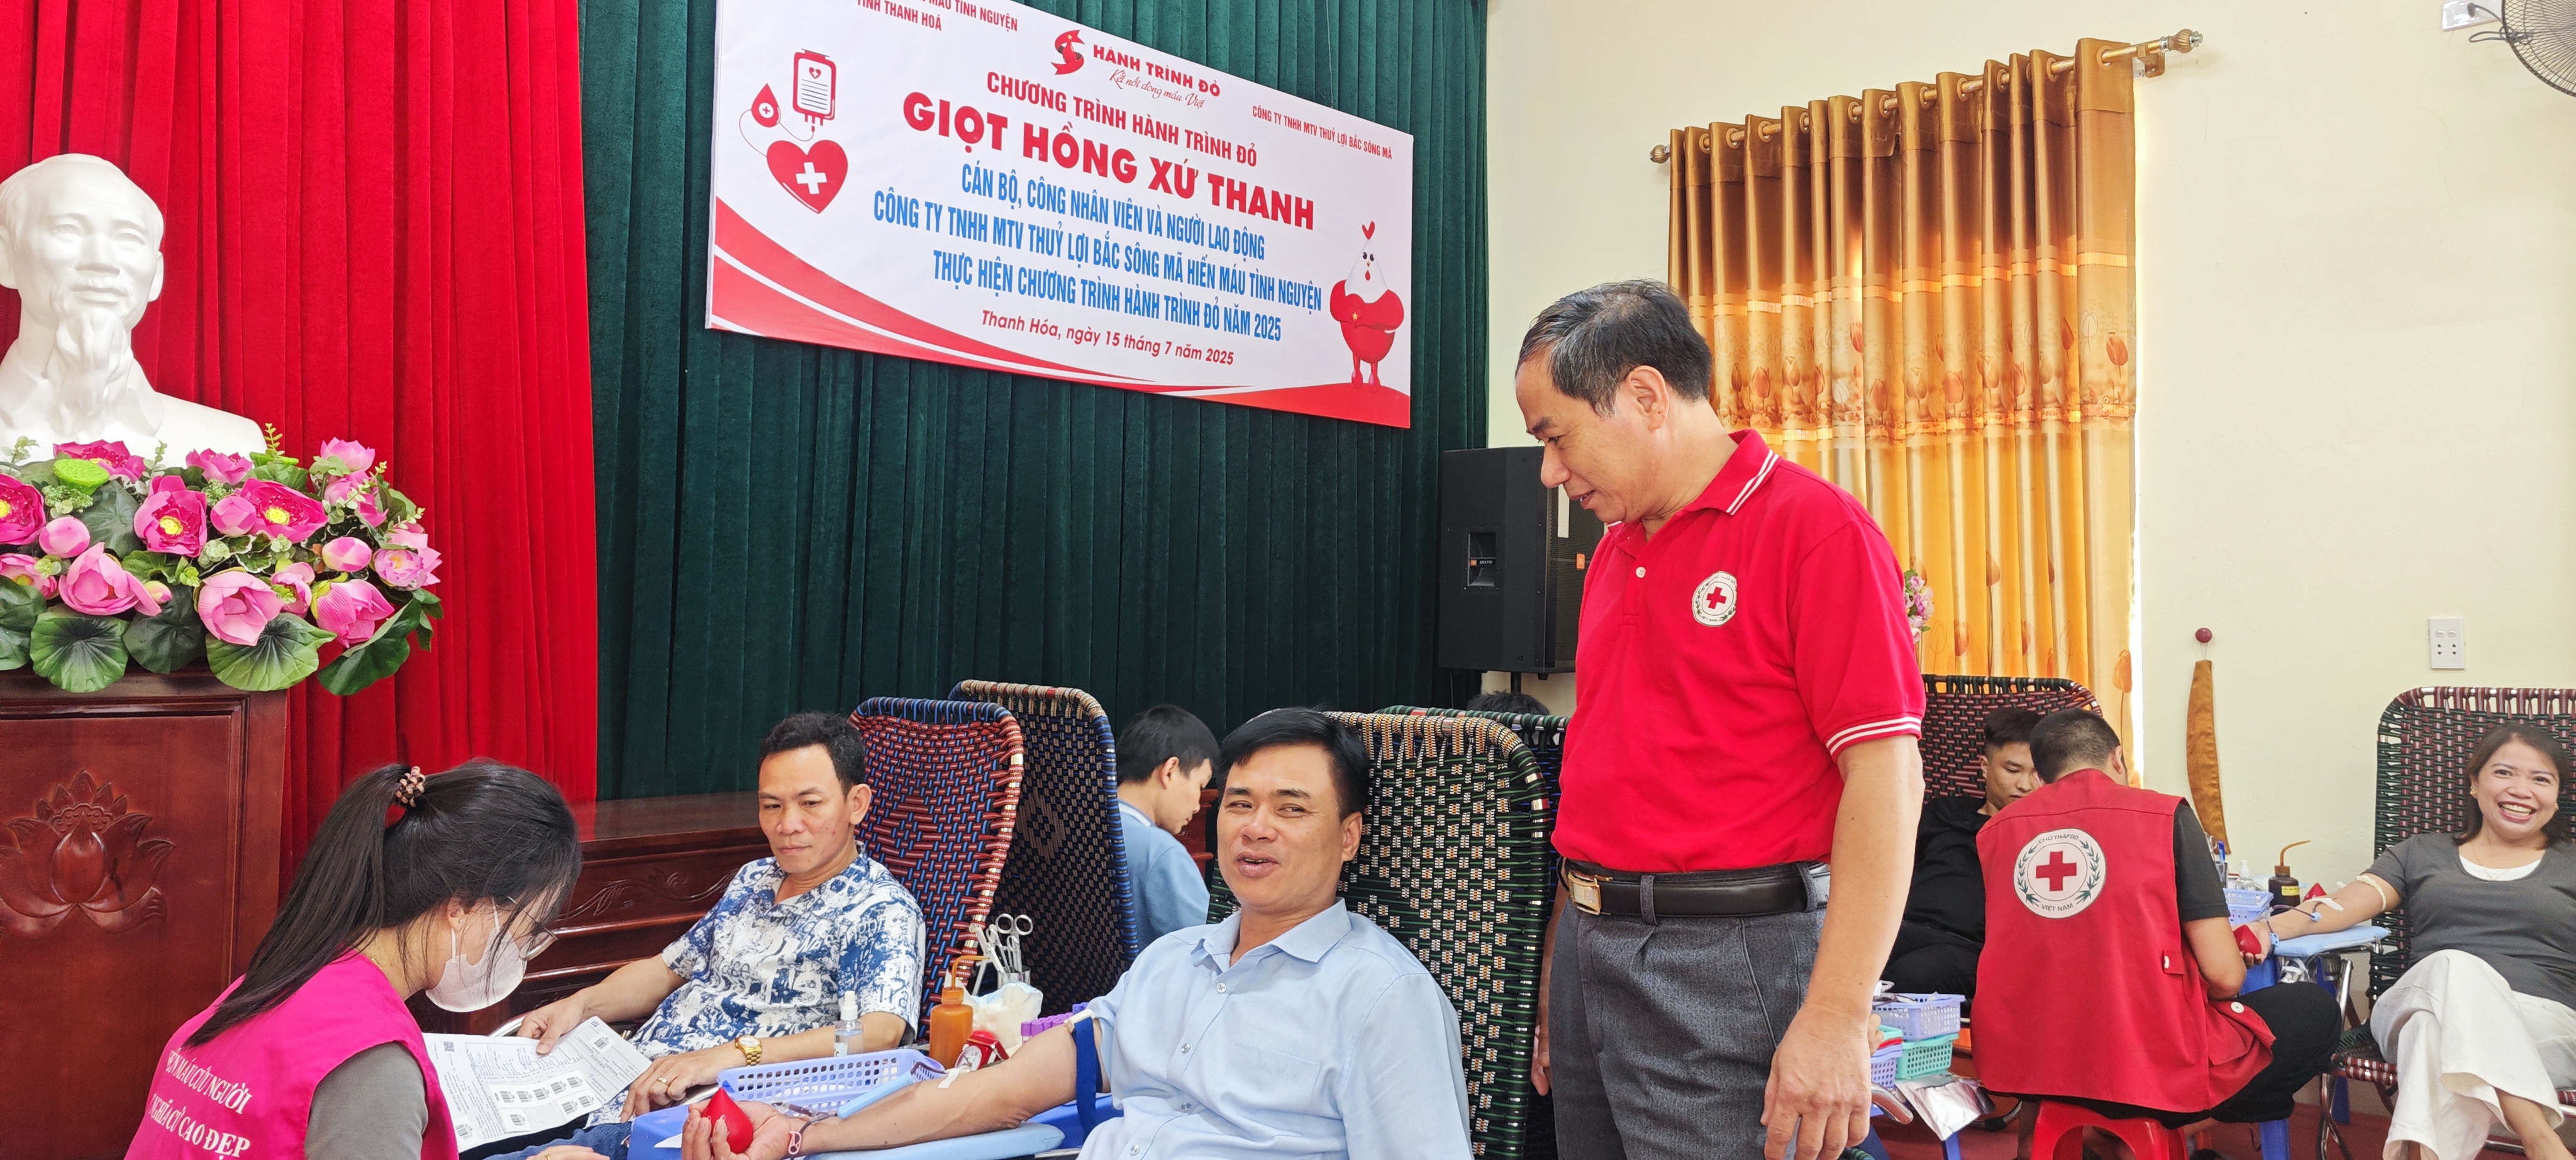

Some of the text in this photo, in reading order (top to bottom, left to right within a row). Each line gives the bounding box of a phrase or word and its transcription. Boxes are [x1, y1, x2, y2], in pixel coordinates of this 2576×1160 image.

[884, 0, 918, 23] THANH
[921, 12, 942, 31] HOÁ
[979, 7, 1018, 31] NGUYỆN
[1094, 44, 1220, 96] HÀNH TRÌNH ĐỎ
[1109, 69, 1205, 109] Kết nối dòng máu Việt
[987, 72, 1257, 167] CHƯƠNG TRÌNH HÀNH TRÌNH ĐỎ
[1253, 105, 1392, 159] CÔNG TY TNHH MTV THUỶ LỢI BẮC SÔNG MÃ
[903, 91, 1314, 230] GIỌT HỒNG XỨ THANH
[962, 160, 1265, 262] CÁN BỘ, CÔNG NHÂN VIÊN VÀ NGƯỜI LAO ĐỘNG
[874, 187, 1322, 315] CÔNG TY TNHH MTV THUỶ LỢI BẮC SÔNG MÃ HIẾN MÁU TÌNH NGUYỆN
[933, 250, 1282, 342] THỰC HIỆN CHƯƠNG TRÌNH HÀNH TRÌNH ĐỎ NĂM 2025
[982, 310, 1235, 365] Thanh Hóa, ngày 15 tháng 7 năm 2025
[2057, 903, 2074, 911] NAM
[203, 1076, 253, 1115] NGƯỜI
[178, 1116, 205, 1145] CAO
[203, 1128, 251, 1160] ĐẸP
